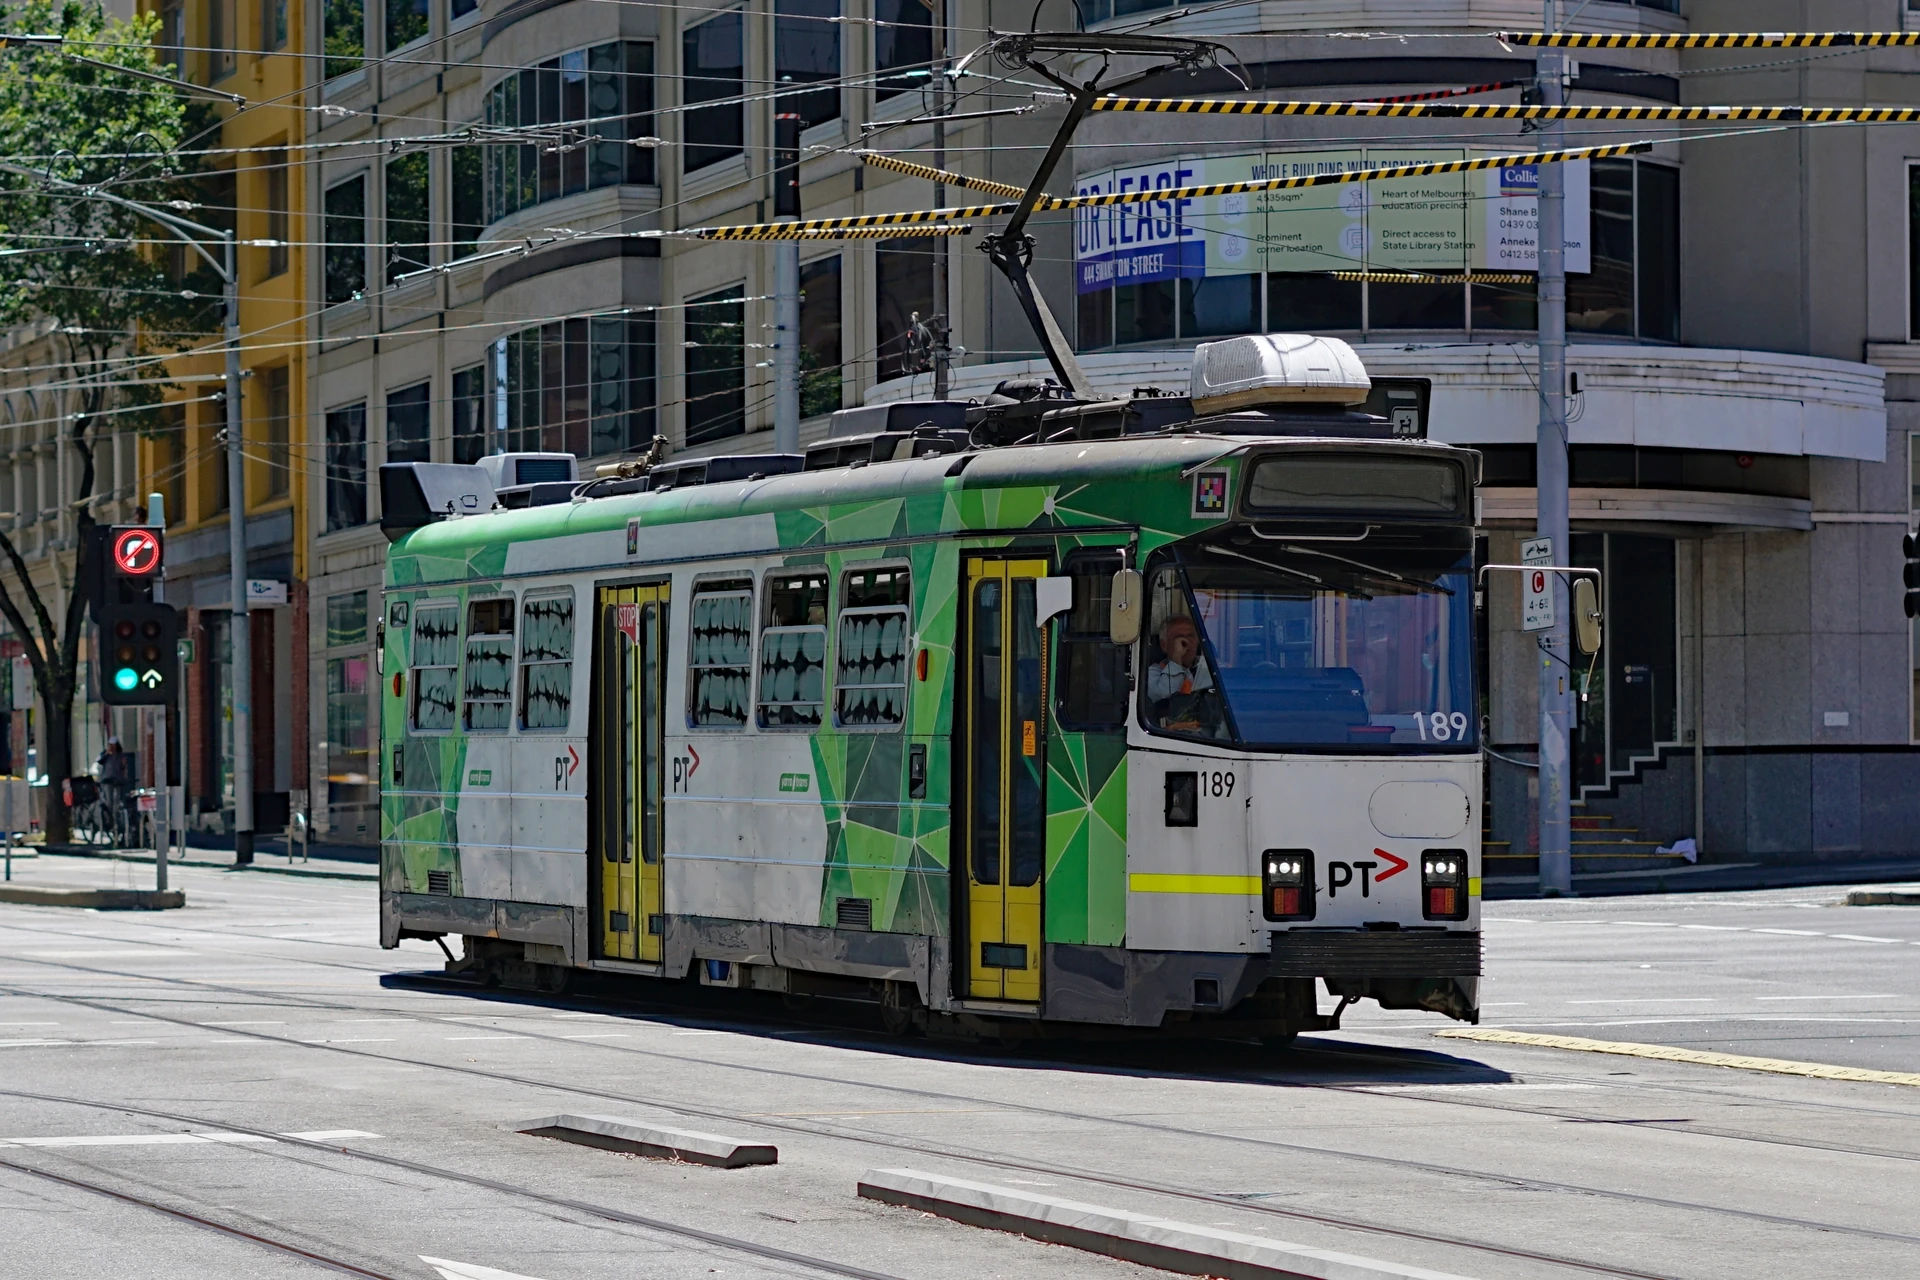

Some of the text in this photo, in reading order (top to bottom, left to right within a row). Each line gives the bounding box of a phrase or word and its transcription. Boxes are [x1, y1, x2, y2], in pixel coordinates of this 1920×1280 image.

[1252, 163, 1288, 180] WHOLE
[1293, 161, 1343, 177] BUILDING
[1352, 160, 1376, 173] WITH
[1382, 190, 1476, 198] Heart of Melbourne's
[1108, 169, 1193, 246] LEASE
[1382, 201, 1468, 211] education precinct
[1500, 206, 1529, 216] Shane
[1500, 219, 1524, 229] 0439
[1256, 233, 1302, 242] Prominent
[1382, 230, 1411, 238] Direct
[1446, 230, 1456, 238] to
[1382, 241, 1476, 251] State Library Staton
[1500, 237, 1535, 246] Anneke
[1256, 243, 1323, 254] corner location
[1500, 249, 1522, 259] 0412
[1083, 253, 1164, 285] 444 SWANSON STREET
[618, 606, 636, 628] STOP
[1412, 711, 1468, 741] 189
[1200, 771, 1236, 798] 189
